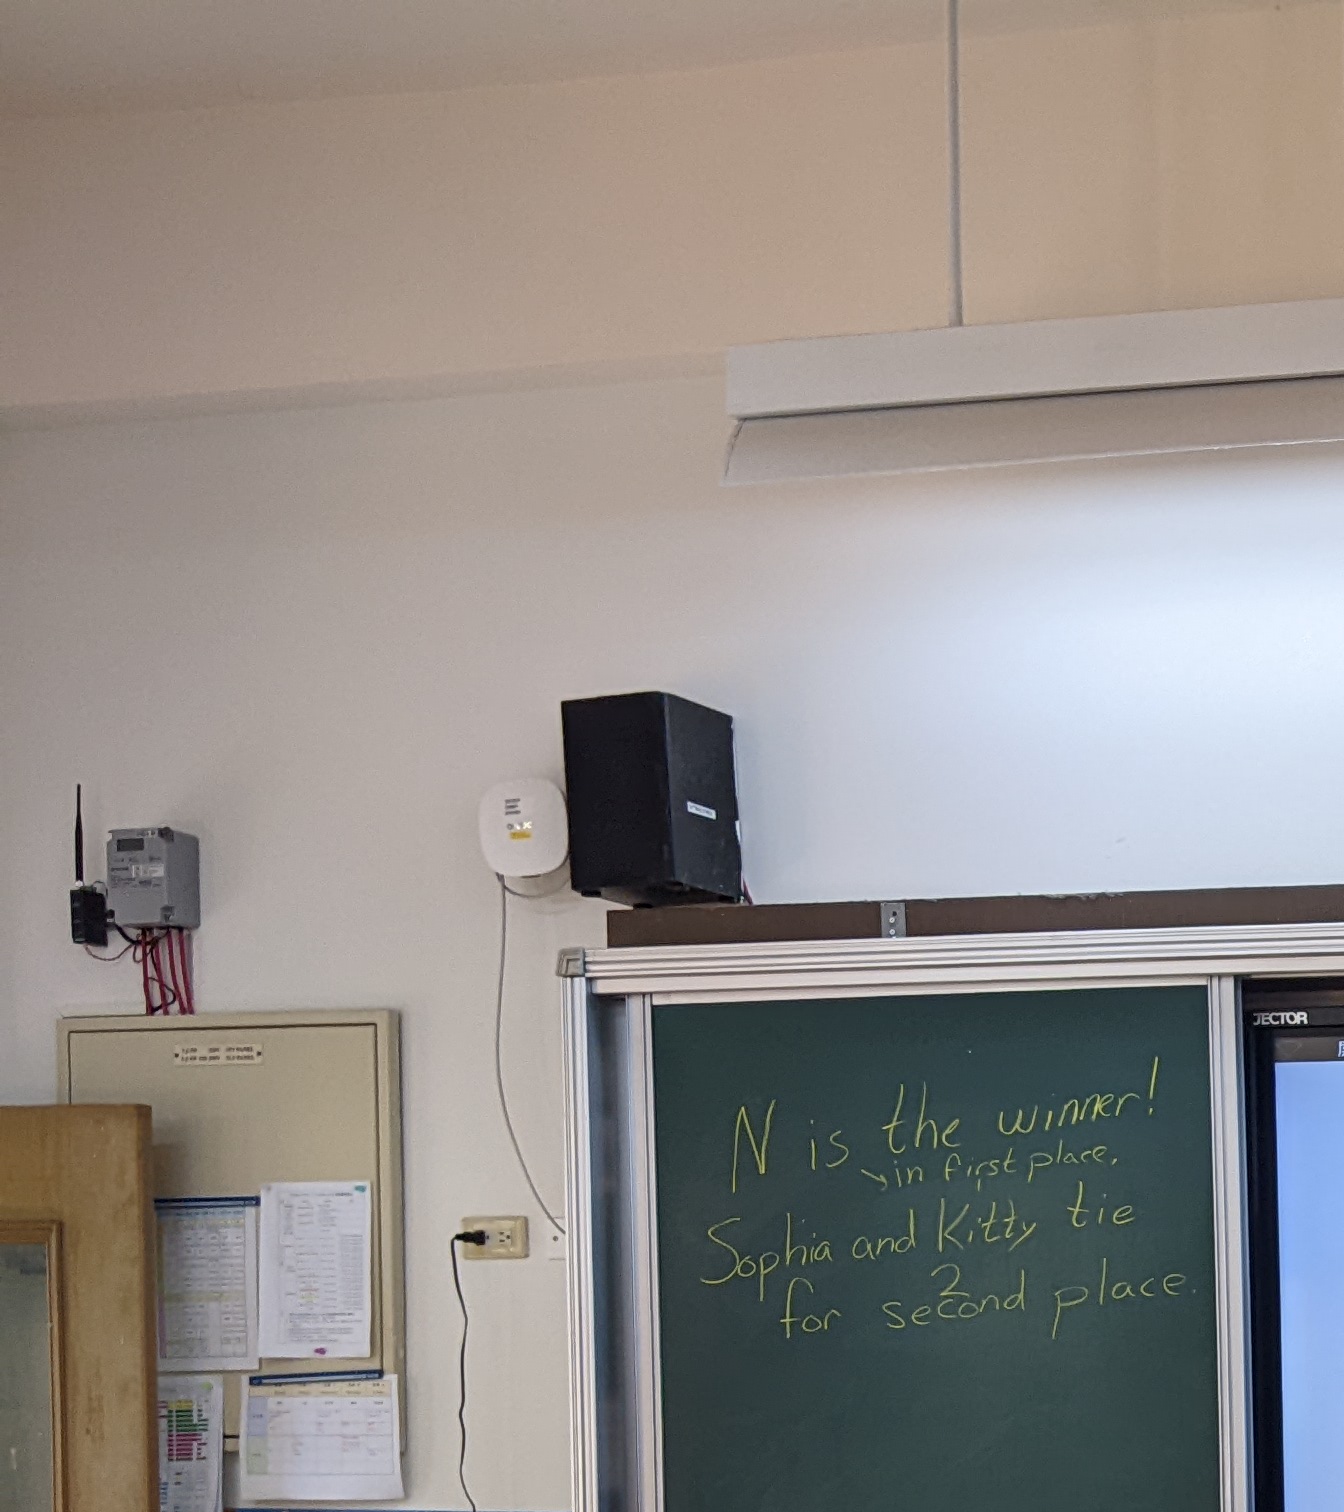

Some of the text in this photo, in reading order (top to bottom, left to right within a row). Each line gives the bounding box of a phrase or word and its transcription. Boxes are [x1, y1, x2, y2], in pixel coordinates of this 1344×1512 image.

[1253, 1011, 1309, 1027] JECTOR
[732, 1056, 1160, 1192] N is the winner!
[894, 1162, 924, 1188] in
[943, 1153, 1017, 1190] first
[701, 1180, 1135, 1301] Sophia and Kitty tie
[780, 1277, 841, 1338] for
[887, 1270, 1025, 1329] second
